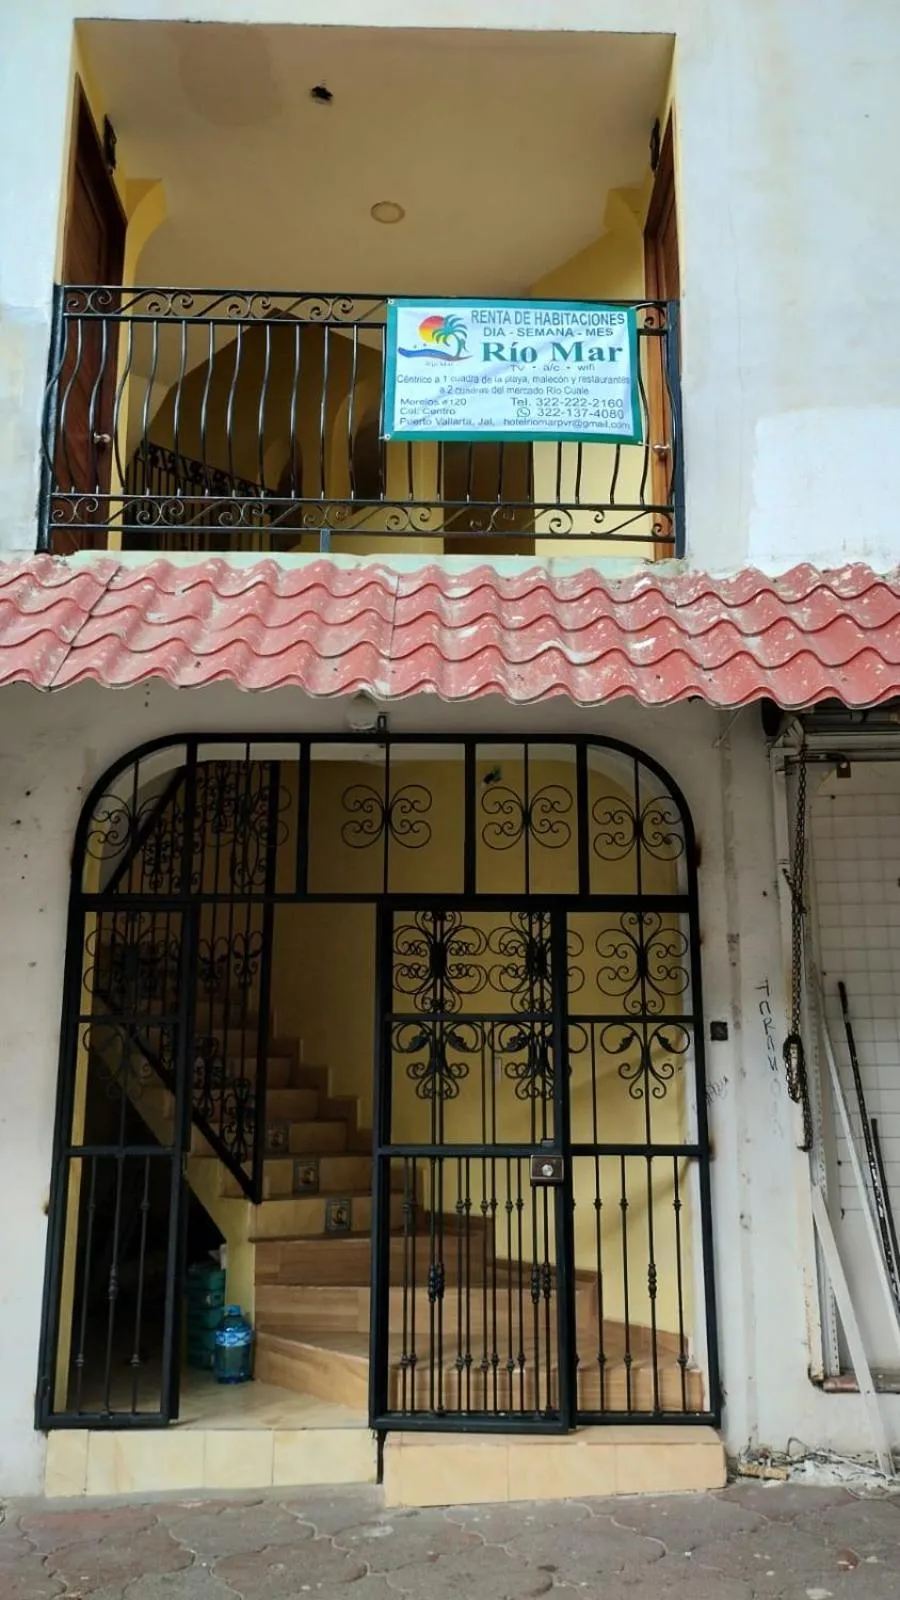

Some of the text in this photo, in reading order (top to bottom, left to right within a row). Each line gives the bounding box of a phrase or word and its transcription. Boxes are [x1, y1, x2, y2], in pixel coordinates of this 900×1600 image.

[471, 310, 625, 326] RENTA DE HABITACIONES
[483, 327, 505, 337] DIA
[517, 327, 575, 337] SEMANA
[585, 328, 613, 337] MES
[482, 341, 623, 363] Río Mar
[543, 364, 560, 372] a/c
[447, 385, 453, 394] 2
[511, 397, 623, 408] Tel. 322-222-2160
[537, 408, 625, 419] 322-137-4080
